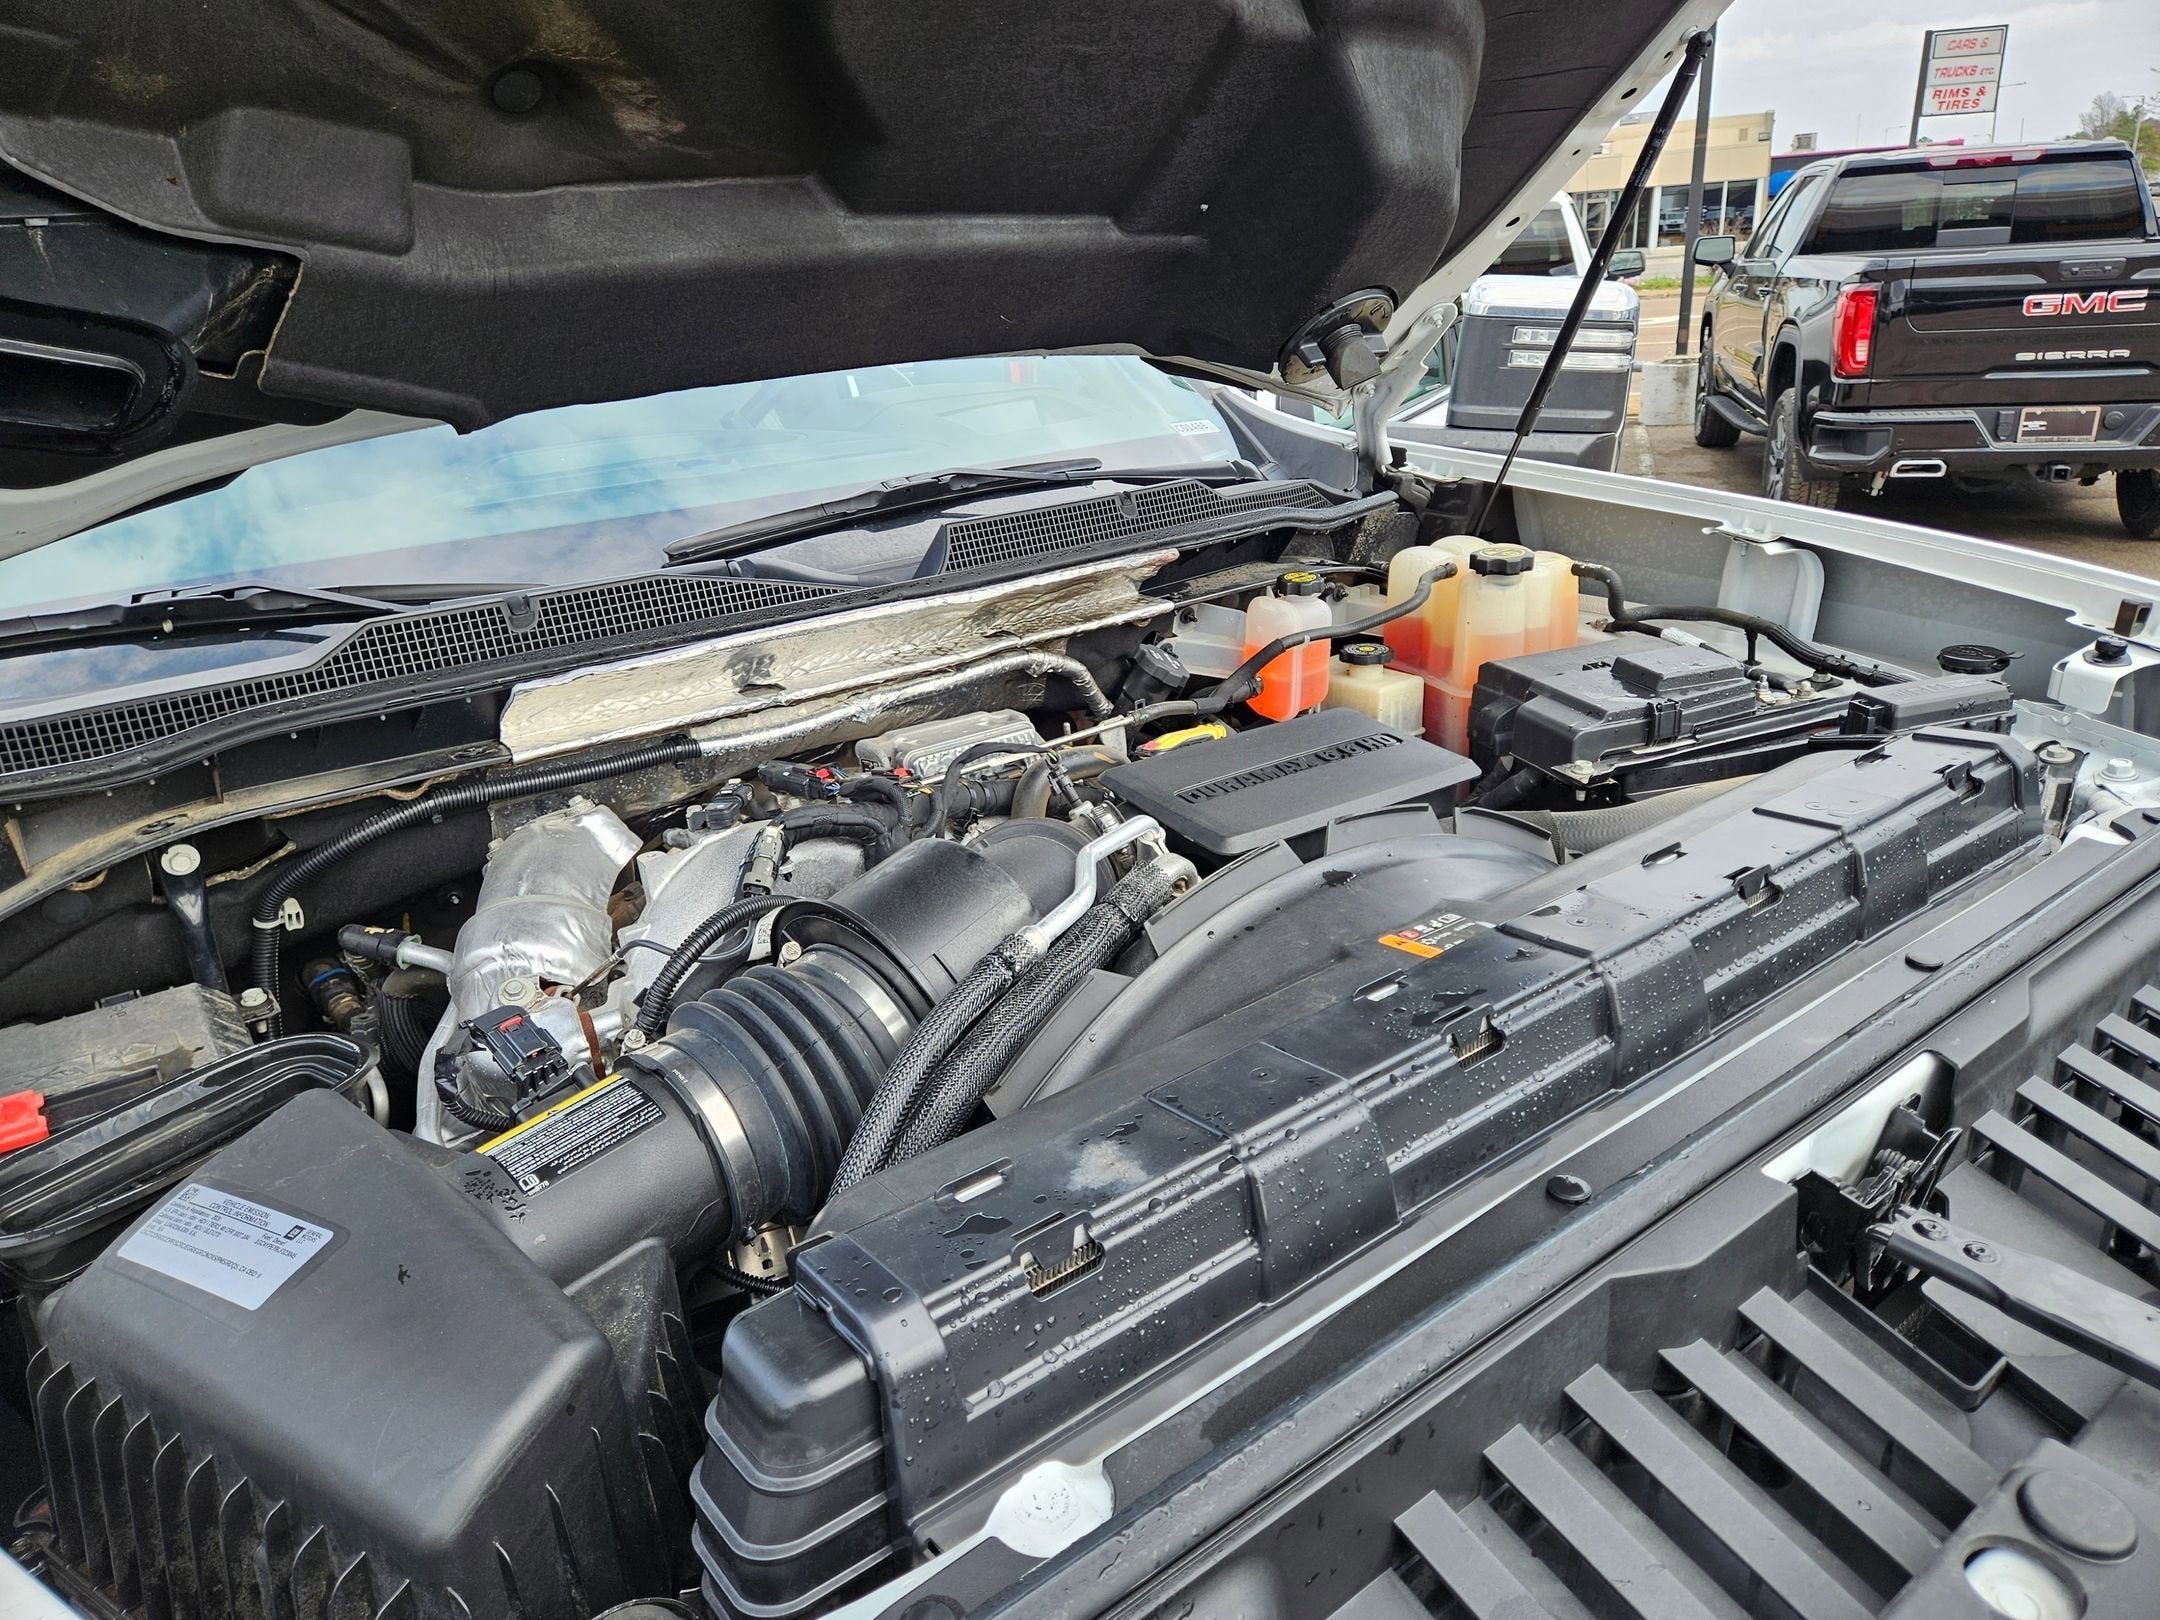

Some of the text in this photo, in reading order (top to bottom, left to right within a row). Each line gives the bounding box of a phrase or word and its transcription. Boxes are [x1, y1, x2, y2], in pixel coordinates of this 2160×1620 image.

[1947, 38, 1978, 51] CARS
[1934, 65, 1978, 79] TRUCKS
[1932, 86, 1987, 100] RIMS &
[1938, 98, 1980, 111] TIRES
[2022, 289, 2149, 317] GMC
[2015, 349, 2131, 361] SIERRA
[1176, 756, 1319, 805] DURAMAX
[208, 1202, 233, 1215] CONTROL
[233, 1209, 271, 1227] INFORMATION
[222, 1199, 244, 1210] VEHICLE
[244, 1205, 272, 1220] EMISSION
